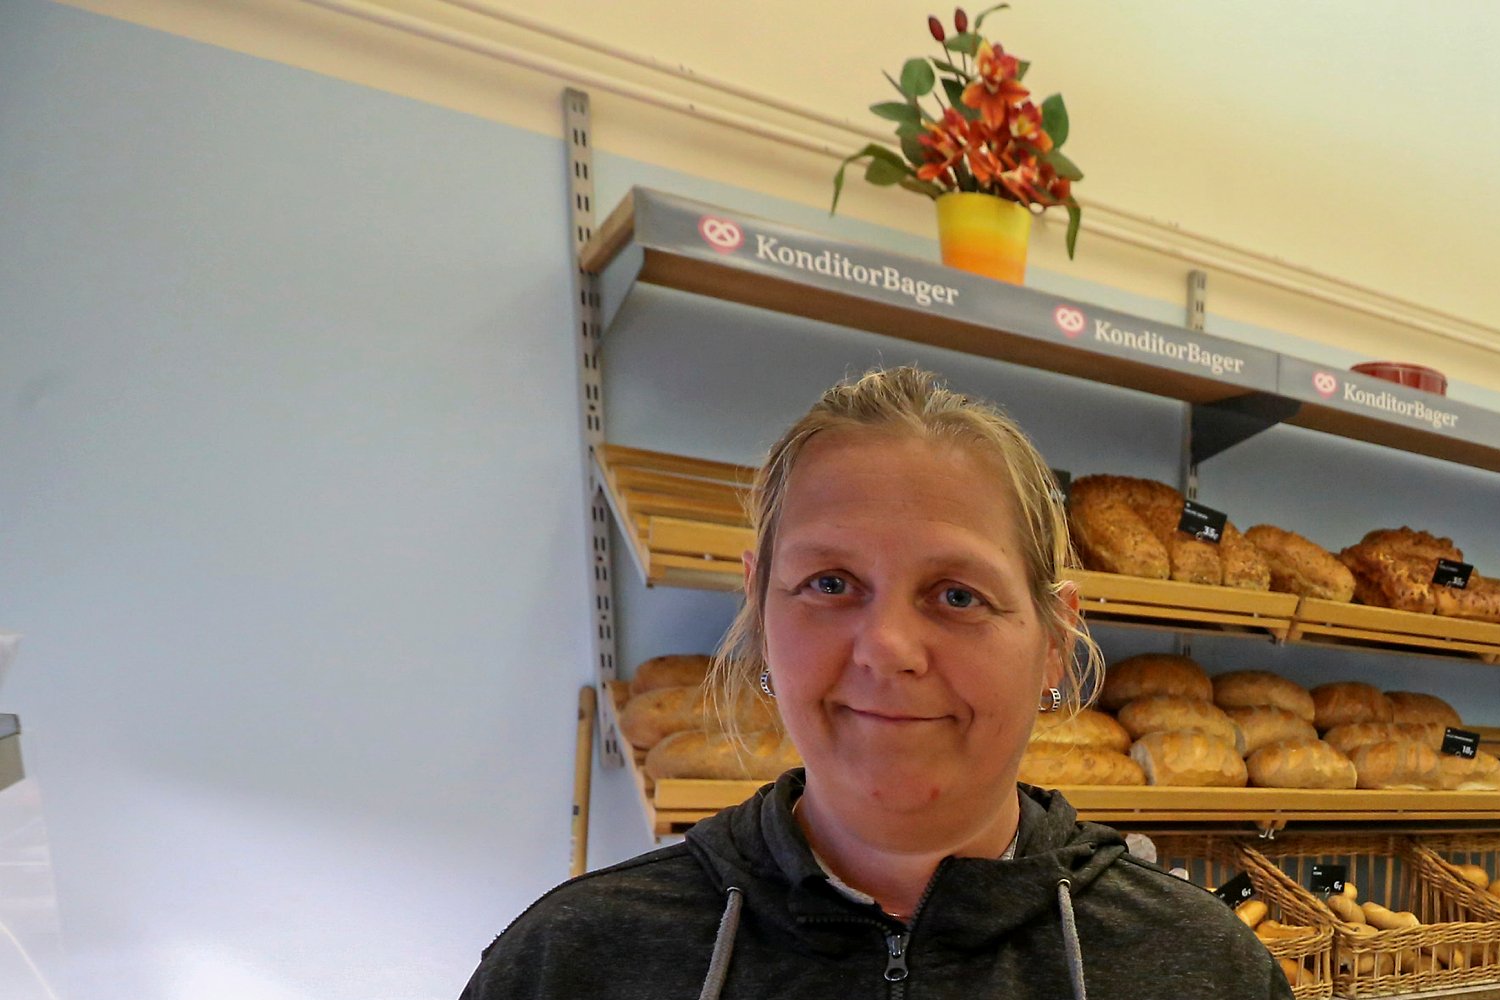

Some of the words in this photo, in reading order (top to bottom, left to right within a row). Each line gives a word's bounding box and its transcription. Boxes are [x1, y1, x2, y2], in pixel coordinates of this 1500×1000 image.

[756, 233, 959, 307] KonditorBager
[1094, 318, 1244, 376] KonditorBager
[1343, 382, 1459, 429] KonditorBager
